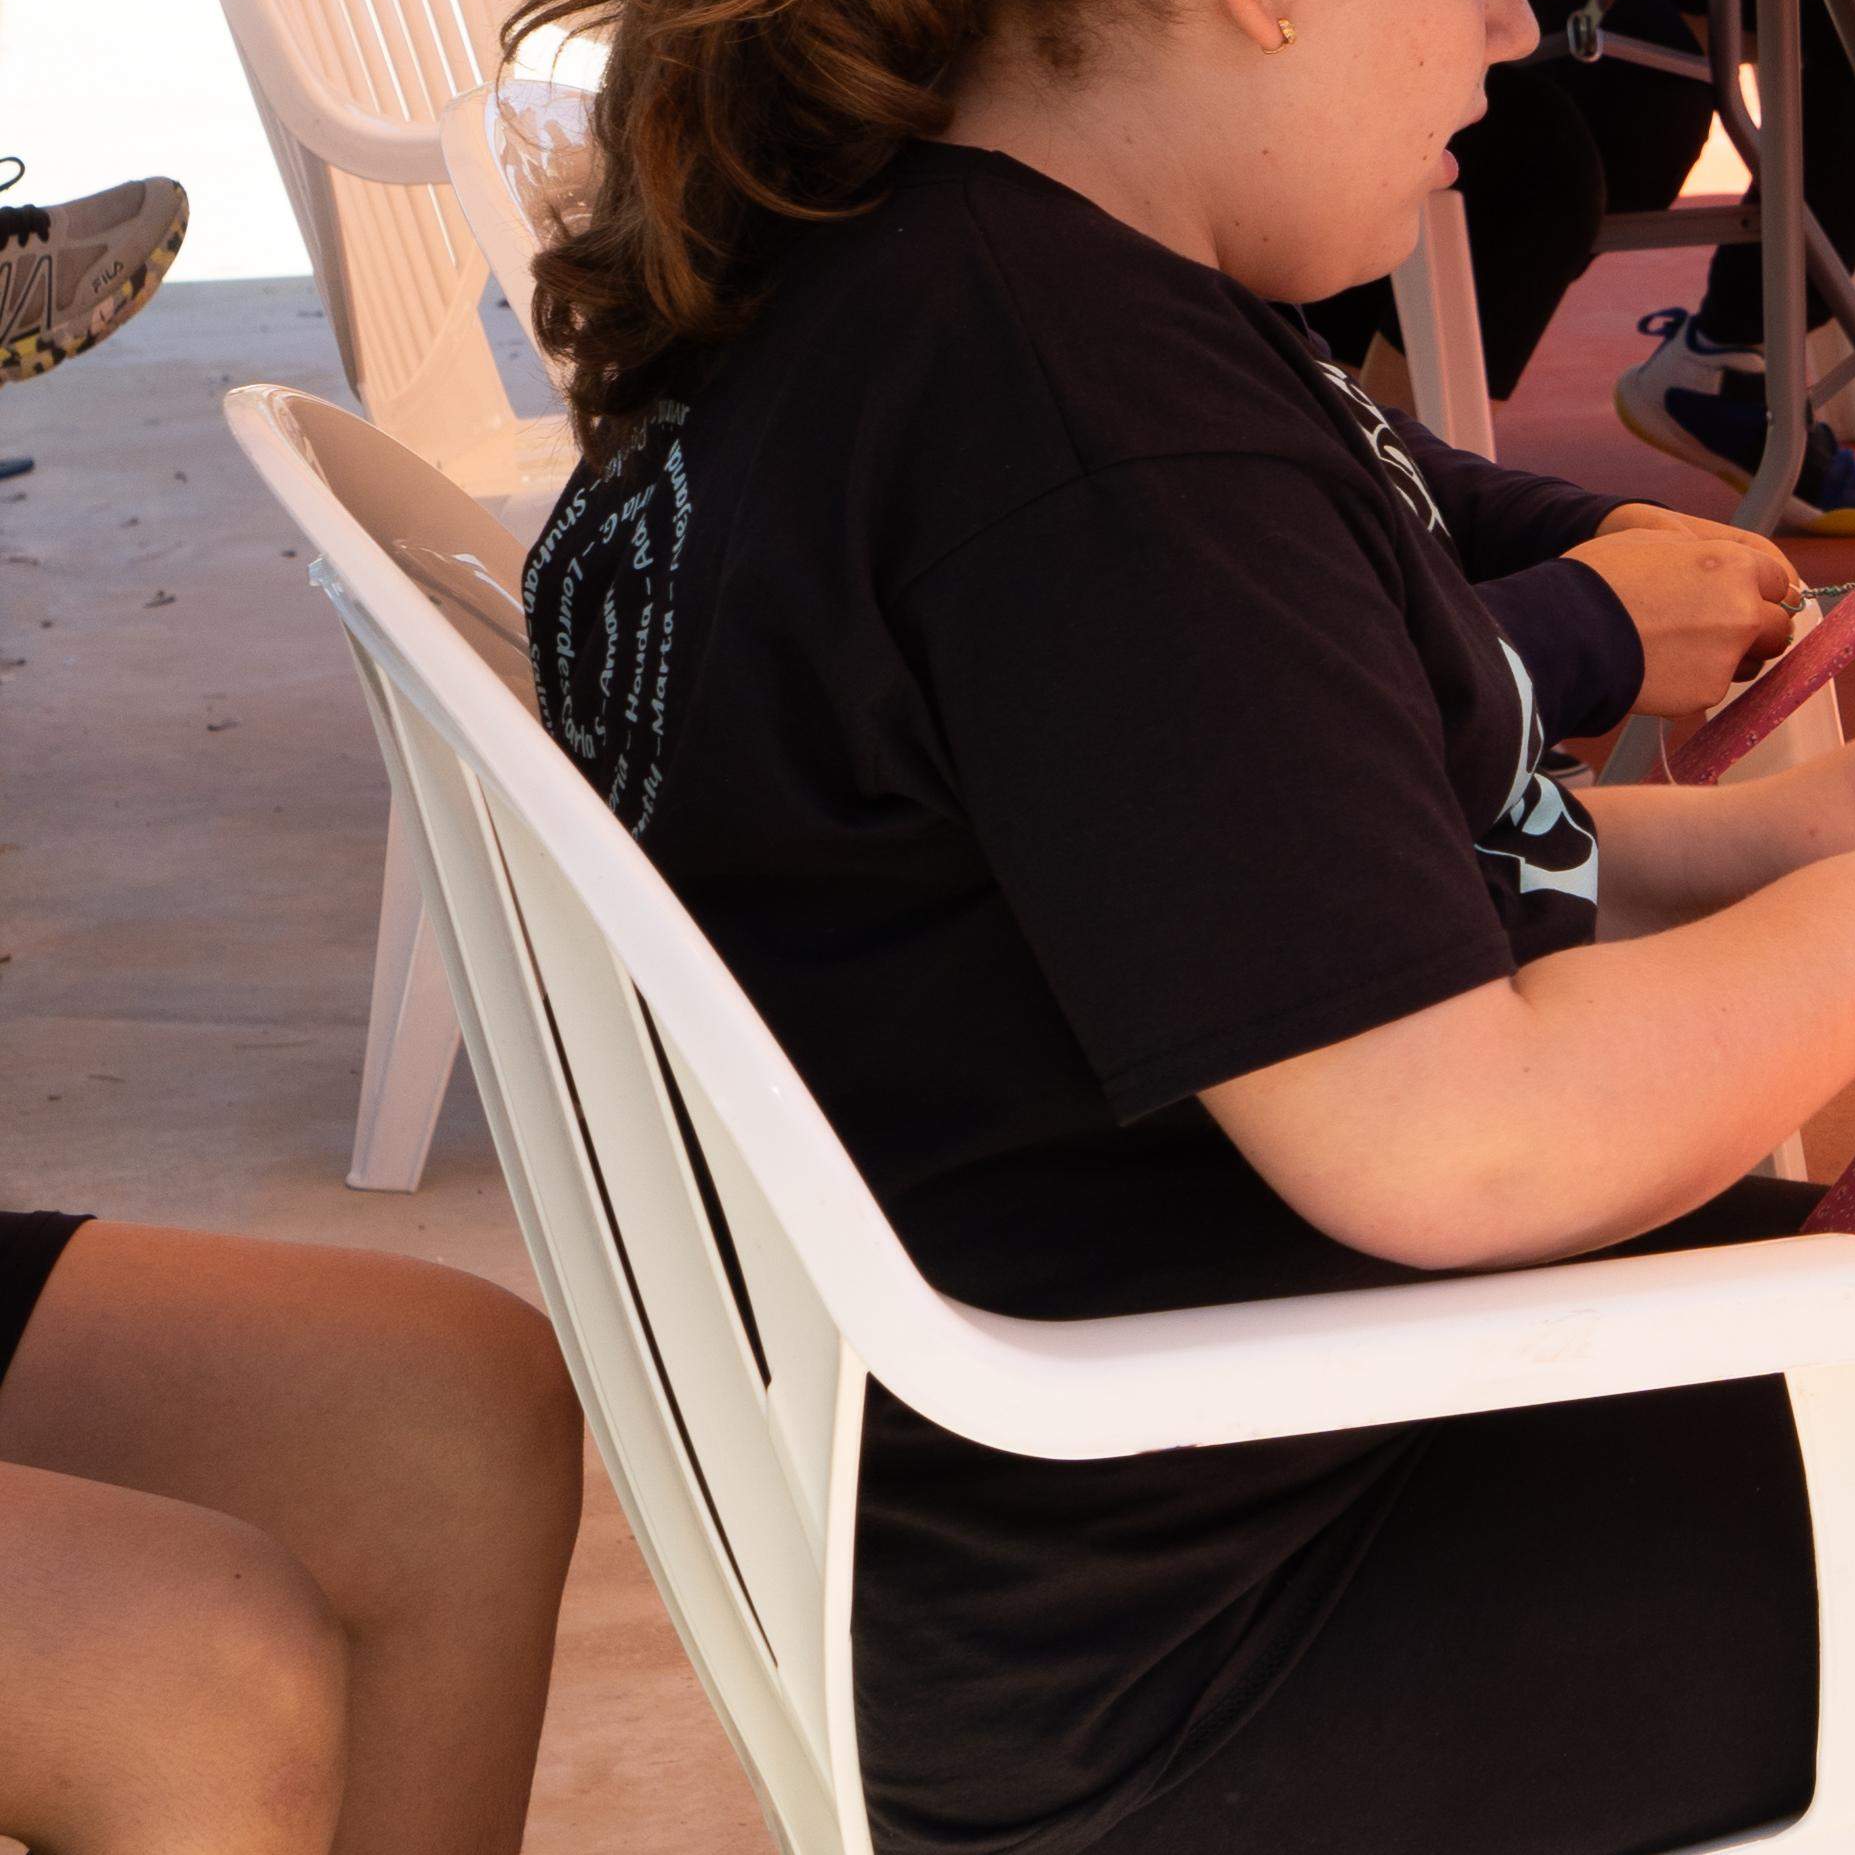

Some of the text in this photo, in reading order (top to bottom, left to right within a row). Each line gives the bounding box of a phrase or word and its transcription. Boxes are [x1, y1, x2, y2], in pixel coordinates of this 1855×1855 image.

[92, 260, 124, 294] FILA
[557, 557, 584, 695] Lourdes
[625, 603, 654, 723] Houda
[652, 610, 674, 736] Marta
